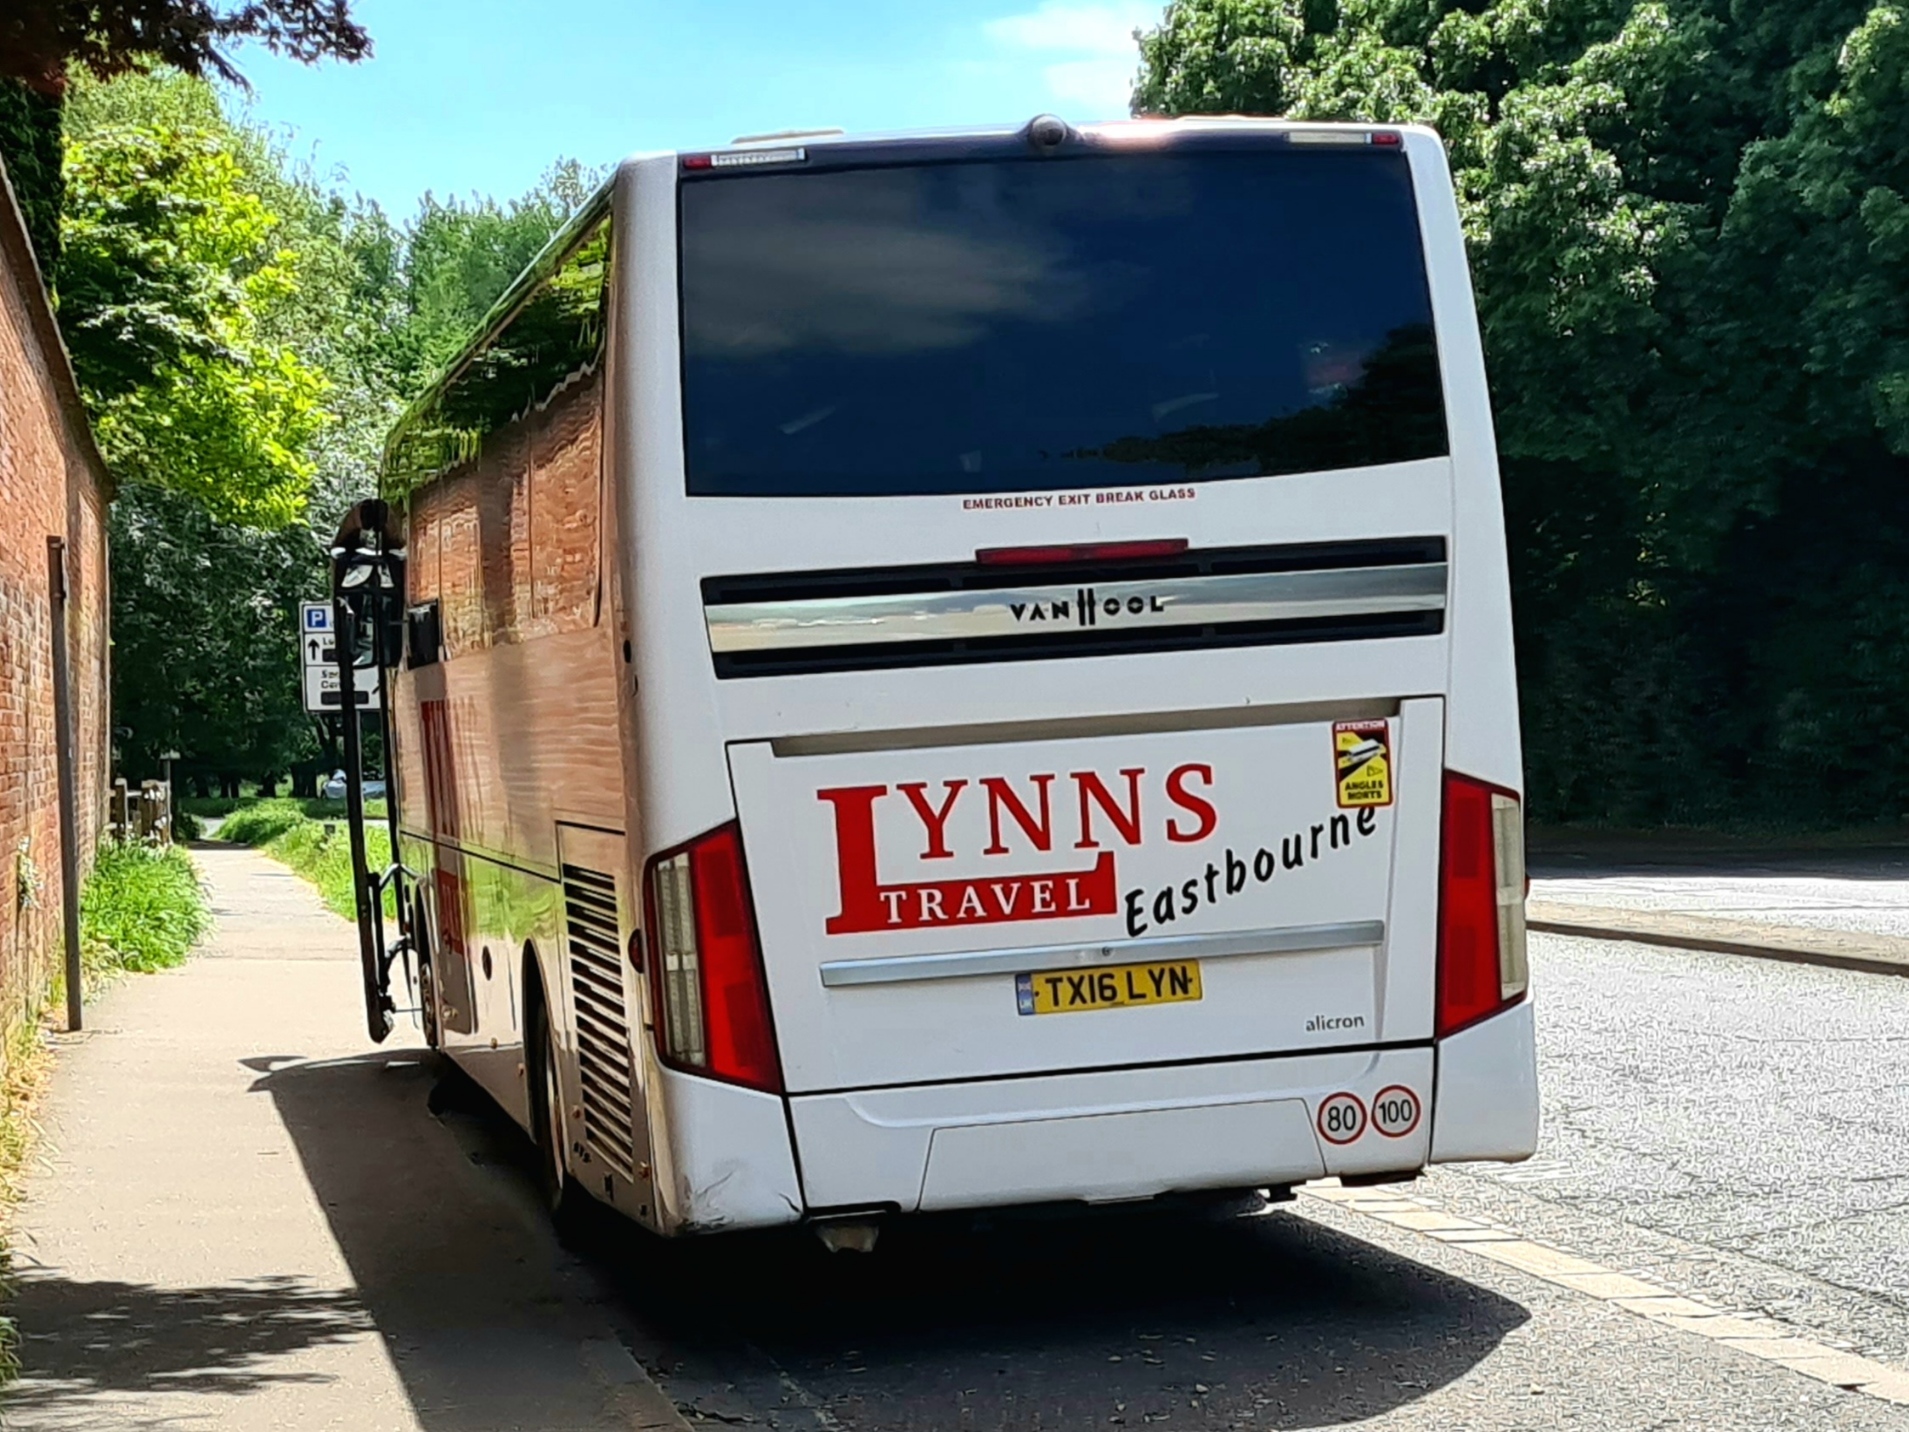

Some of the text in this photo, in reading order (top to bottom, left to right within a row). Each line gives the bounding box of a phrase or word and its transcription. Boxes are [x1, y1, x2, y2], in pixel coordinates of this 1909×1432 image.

[963, 488, 1196, 509] EMERGENCY EXIT BREAK GLASS
[311, 611, 324, 627] P
[1345, 780, 1384, 791] ANGLES
[1347, 791, 1382, 800] MORTS
[817, 763, 1217, 935] LYNNS
[1125, 806, 1377, 937] Eastbourne
[880, 878, 1091, 924] TRAVEL
[1045, 965, 1190, 1007] TX16 LYN
[1306, 1015, 1364, 1031] alicron
[1327, 1106, 1357, 1132] 80
[1378, 1099, 1413, 1124] 100
